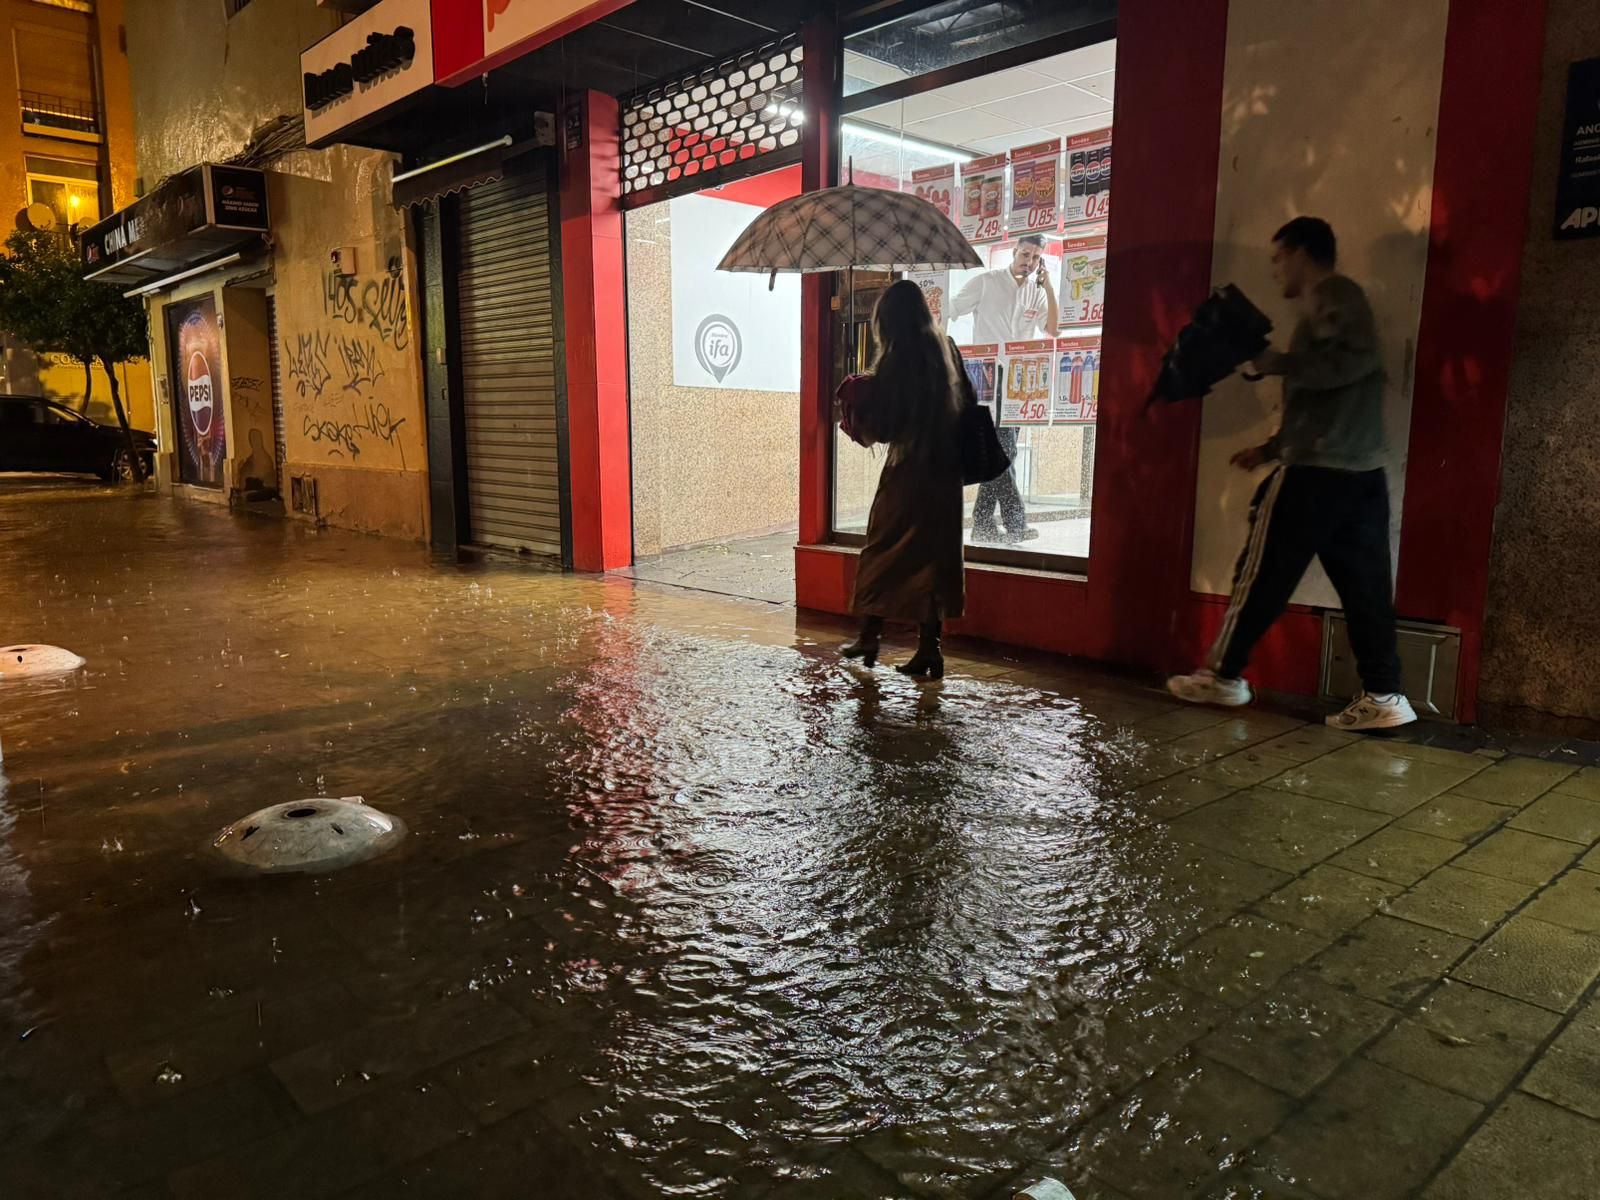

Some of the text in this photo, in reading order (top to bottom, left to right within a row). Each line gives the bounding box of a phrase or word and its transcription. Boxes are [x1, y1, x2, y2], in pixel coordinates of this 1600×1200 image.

[104, 225, 128, 256] CHINA
[709, 338, 729, 359] ifa
[189, 383, 211, 404] PEPSI
